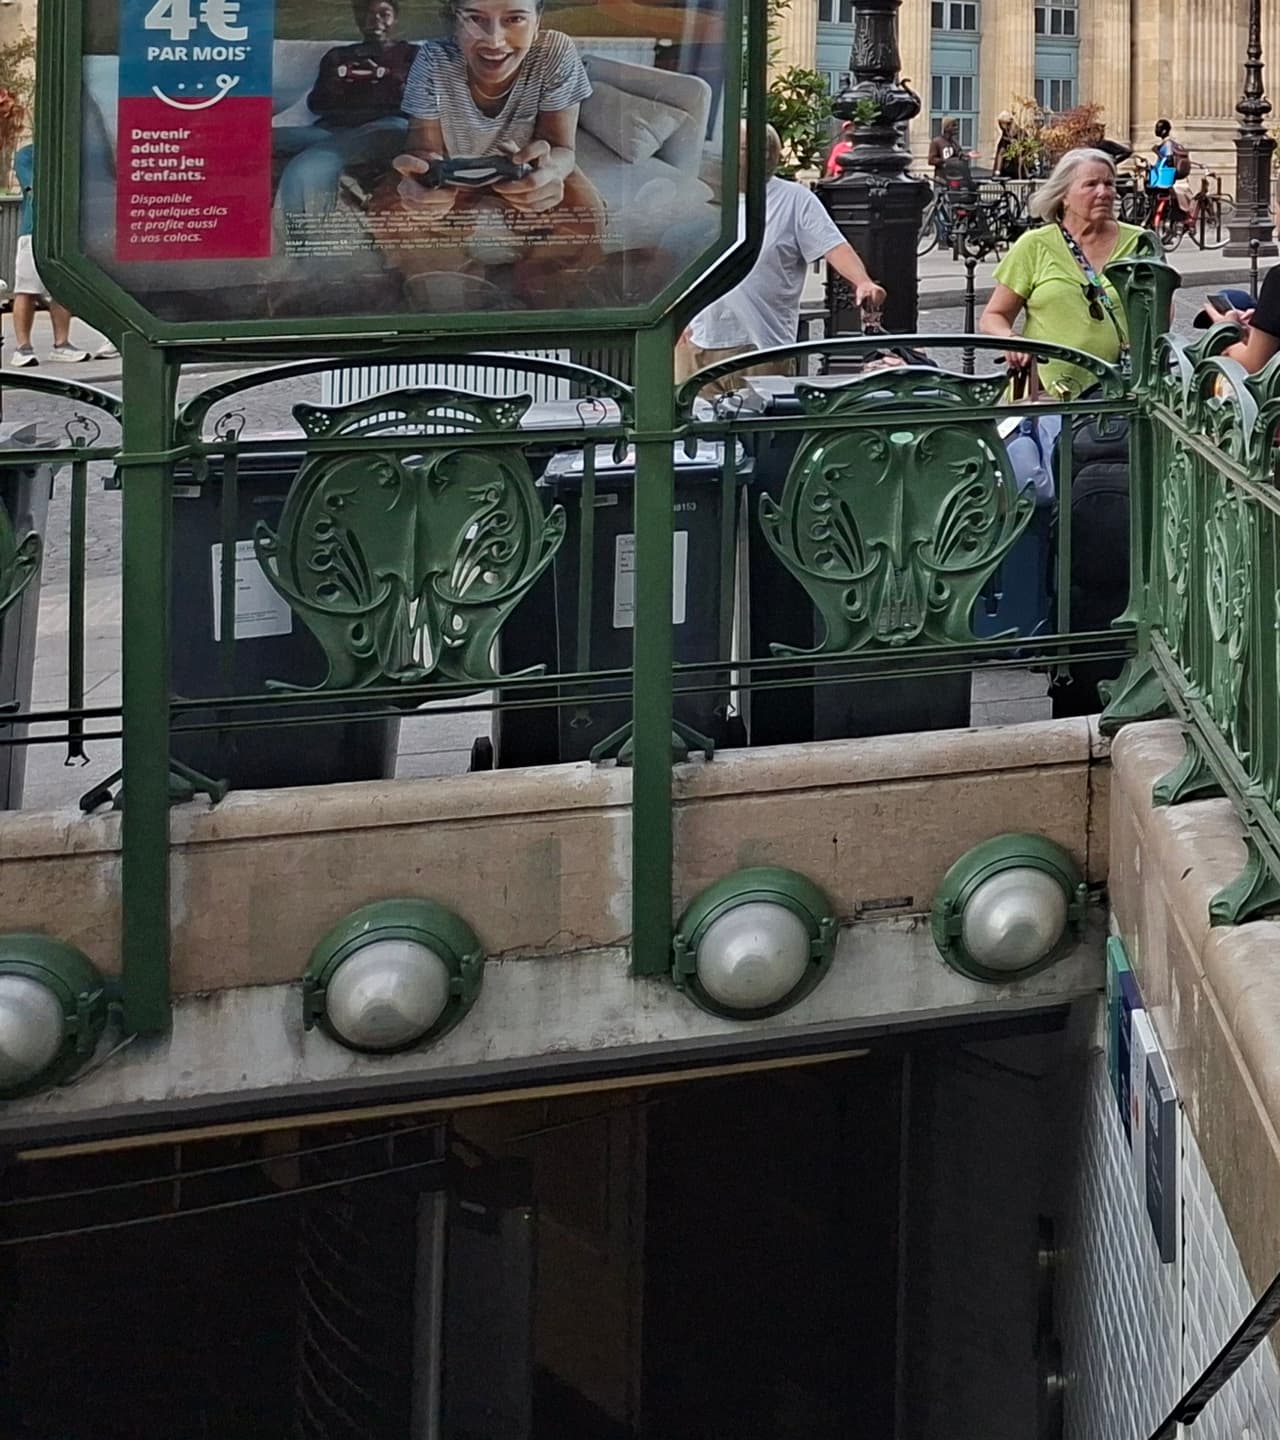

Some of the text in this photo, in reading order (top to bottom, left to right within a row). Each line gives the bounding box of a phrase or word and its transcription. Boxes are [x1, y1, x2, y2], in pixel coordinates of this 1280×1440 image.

[147, 47, 188, 61] PAR
[131, 128, 191, 140] Devenir
[131, 143, 180, 153] adulte
[131, 156, 205, 169] est un jeu
[131, 194, 193, 205] Disponible
[131, 206, 228, 219] en quelques clics
[130, 218, 218, 232] et profite aussi
[140, 234, 160, 243] vos
